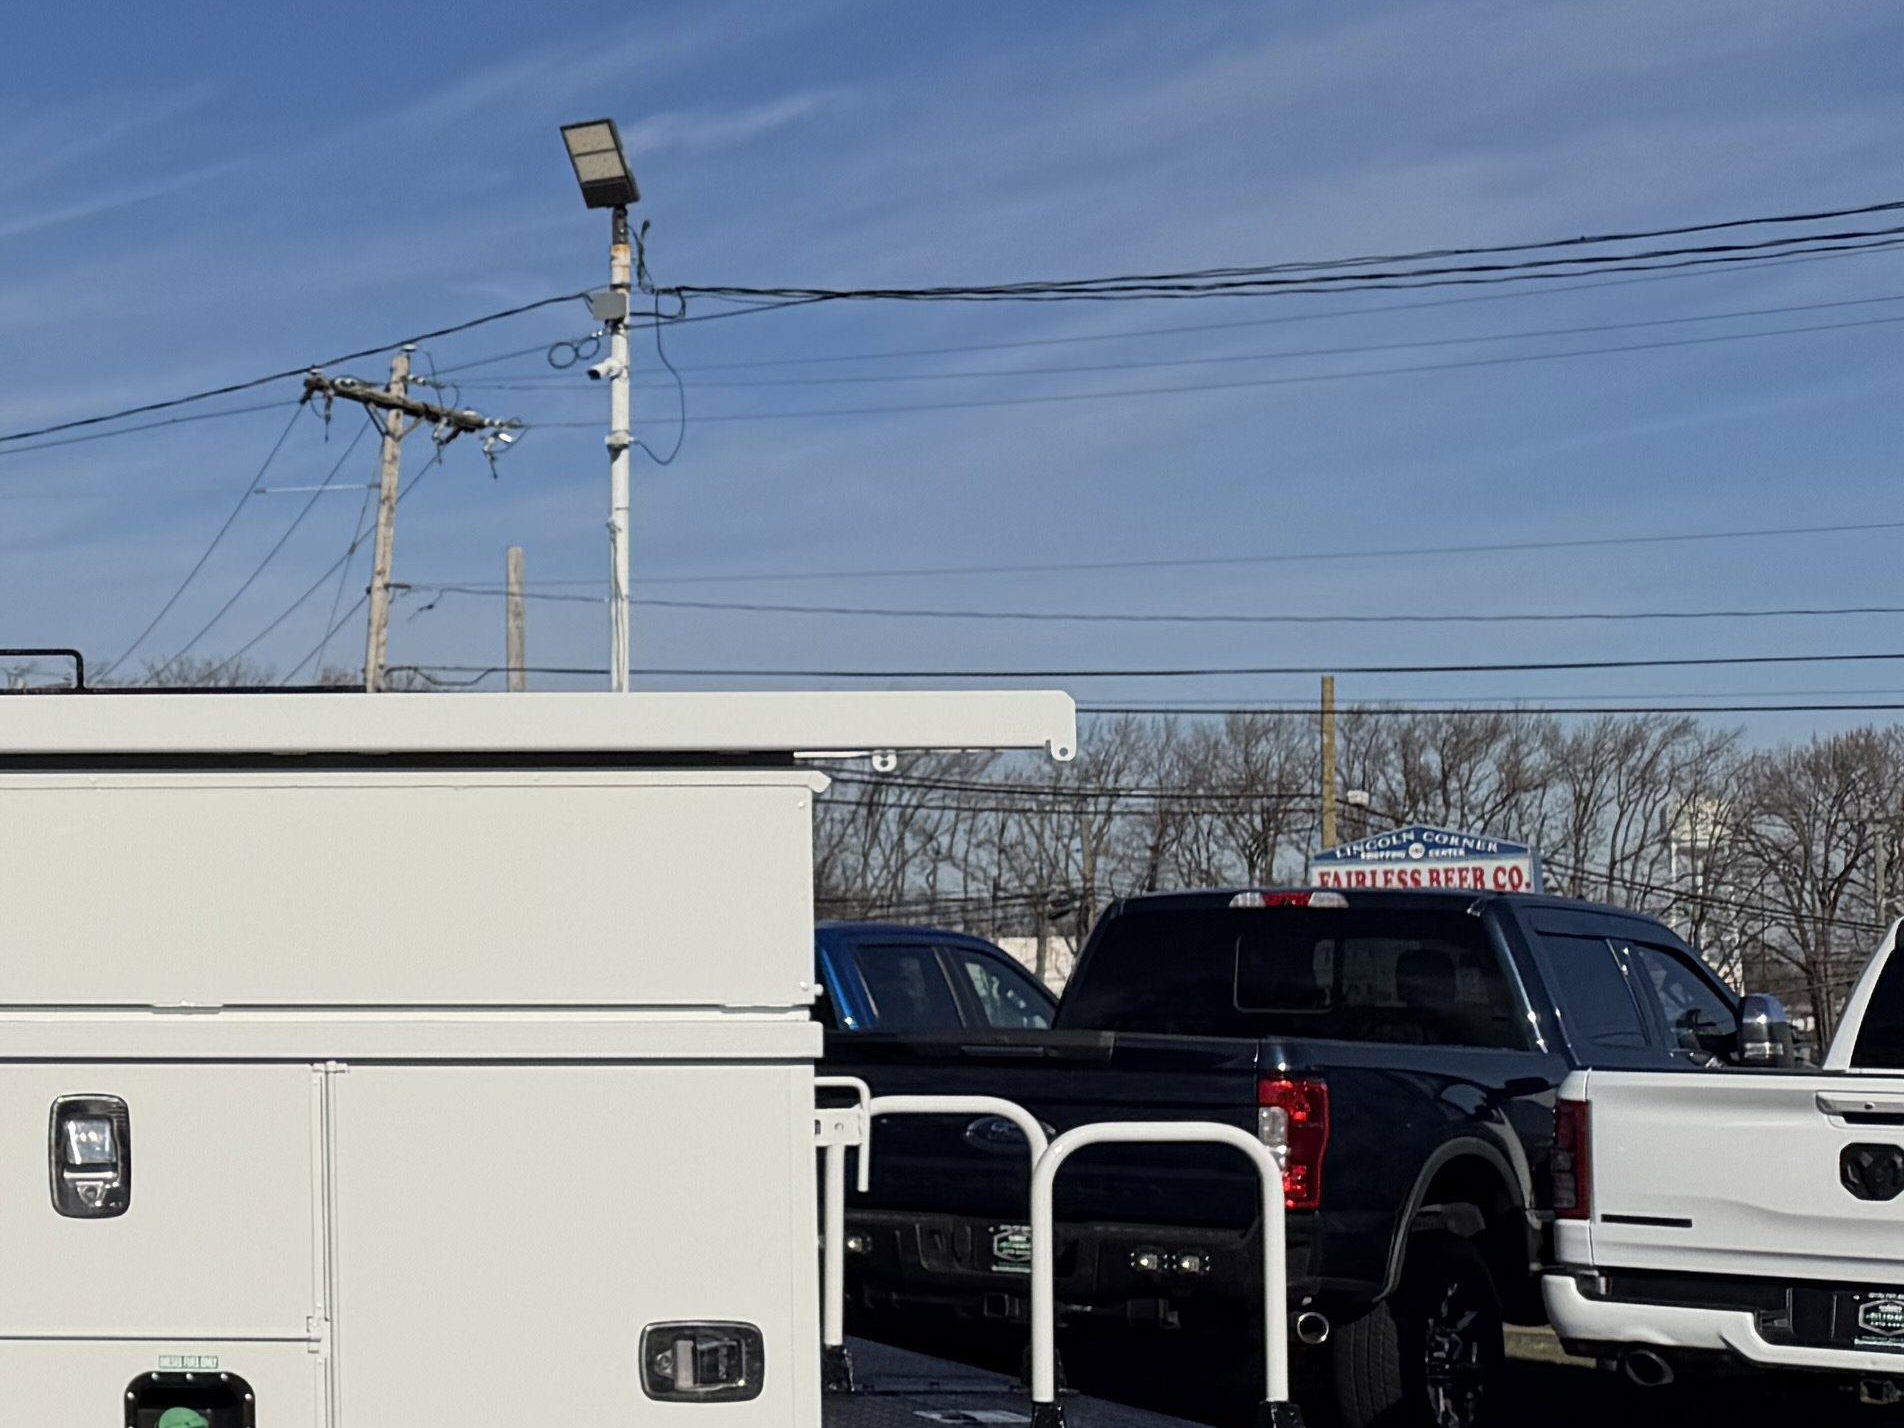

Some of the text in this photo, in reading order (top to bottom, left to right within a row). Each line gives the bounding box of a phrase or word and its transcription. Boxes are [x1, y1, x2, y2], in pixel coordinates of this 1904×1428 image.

[1336, 830, 1415, 859] LINCOLN
[1423, 831, 1499, 853] CORNER
[1428, 847, 1465, 858] CENTER
[1318, 865, 1532, 892] FAIRLESS BEER CO.
